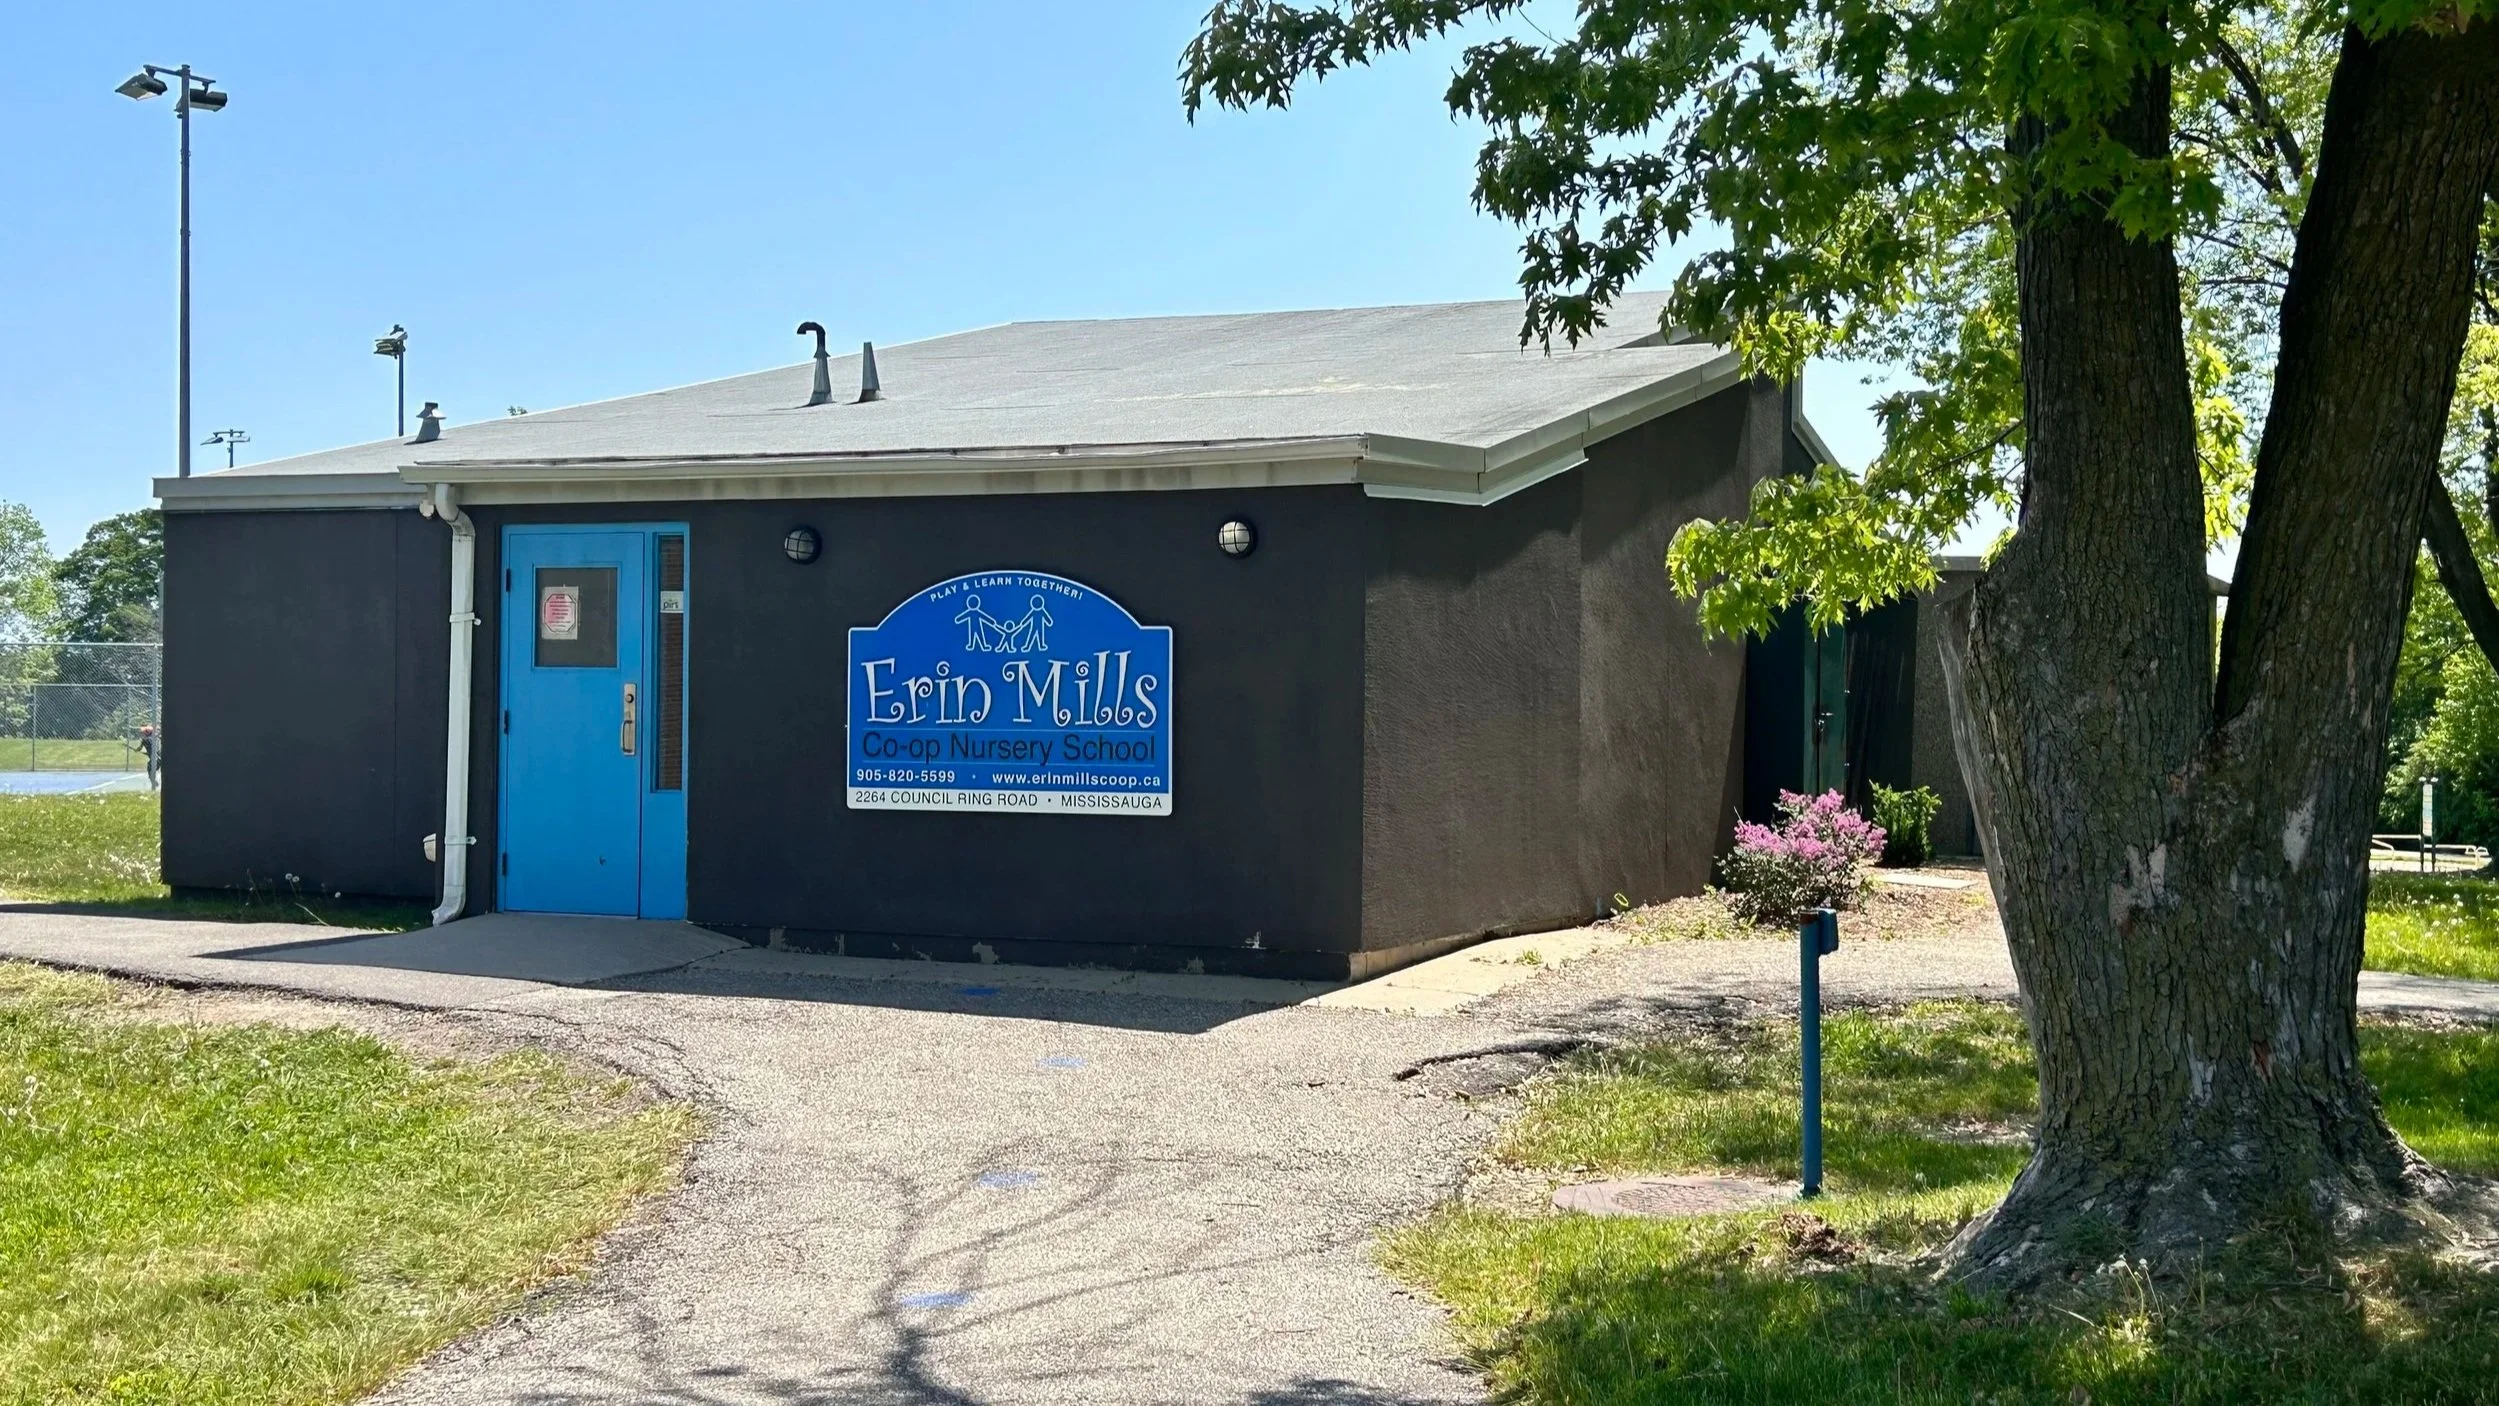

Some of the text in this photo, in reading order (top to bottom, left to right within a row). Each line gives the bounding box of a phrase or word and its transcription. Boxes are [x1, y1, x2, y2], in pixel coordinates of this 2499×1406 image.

[930, 577, 1083, 602] PLAY & LEARN TOGETHER!
[860, 650, 1158, 728] Erin Mills
[863, 731, 1155, 766] Co-op Nursery School
[856, 768, 1161, 788] 905-820-5599 www.erinmillscoop.ca
[855, 791, 1162, 809] 2264 COUNCIL RING ROAD MISSISSAUGA
